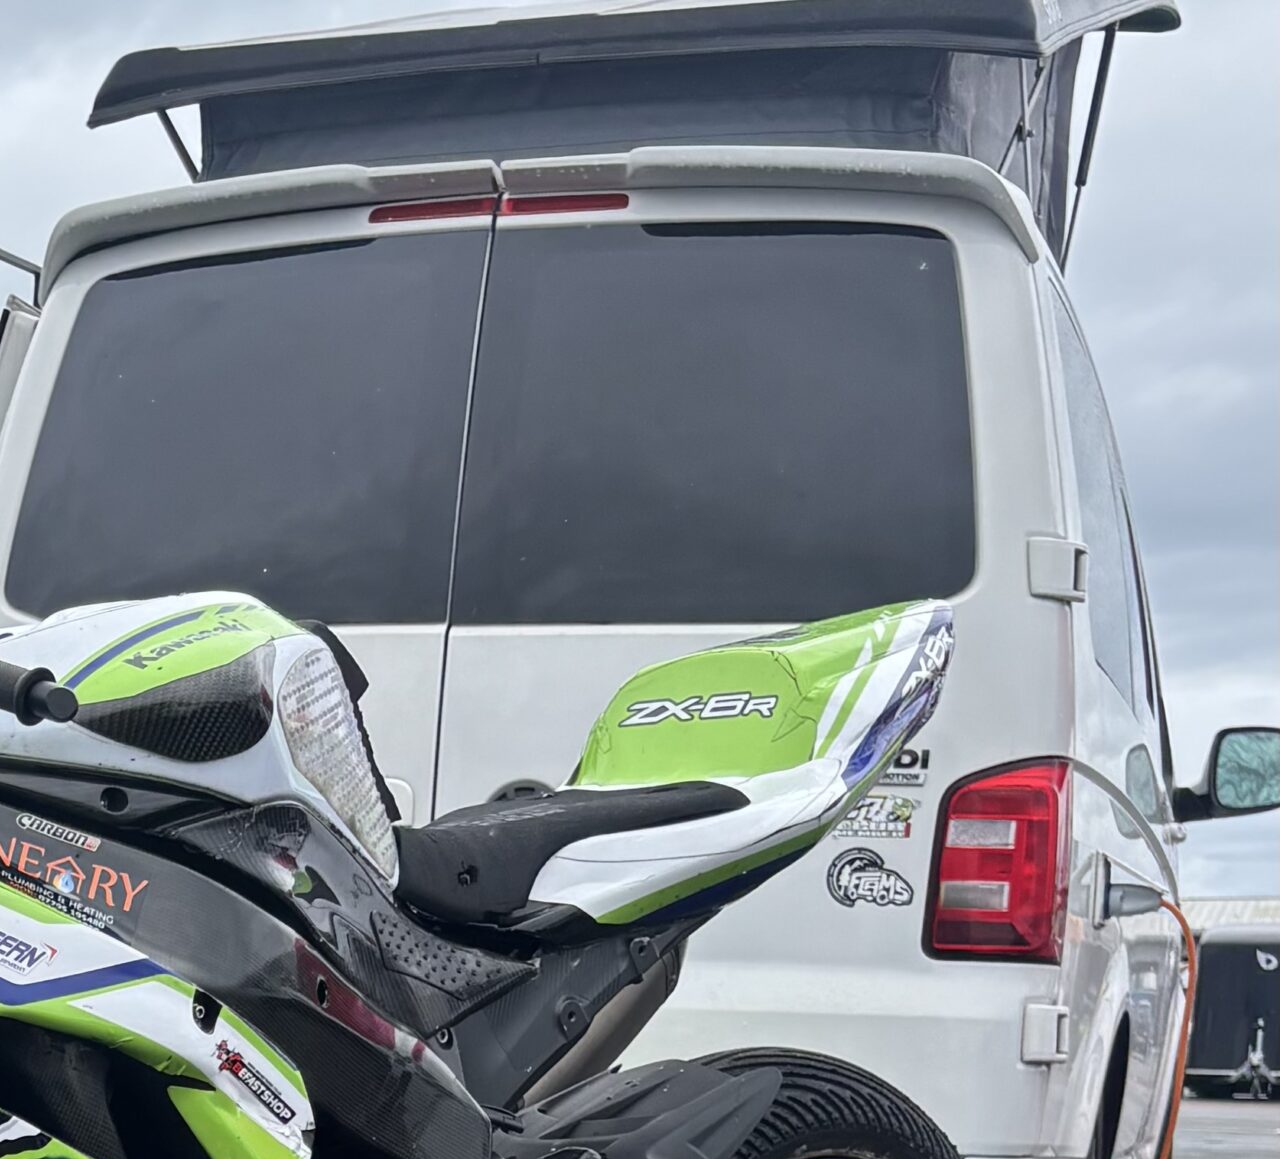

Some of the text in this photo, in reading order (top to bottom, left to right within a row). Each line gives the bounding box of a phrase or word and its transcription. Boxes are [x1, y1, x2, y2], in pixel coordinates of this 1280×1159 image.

[618, 691, 779, 728] ZX-6R
[1, 869, 54, 900] PLUMBING
[69, 897, 114, 925] HEATING
